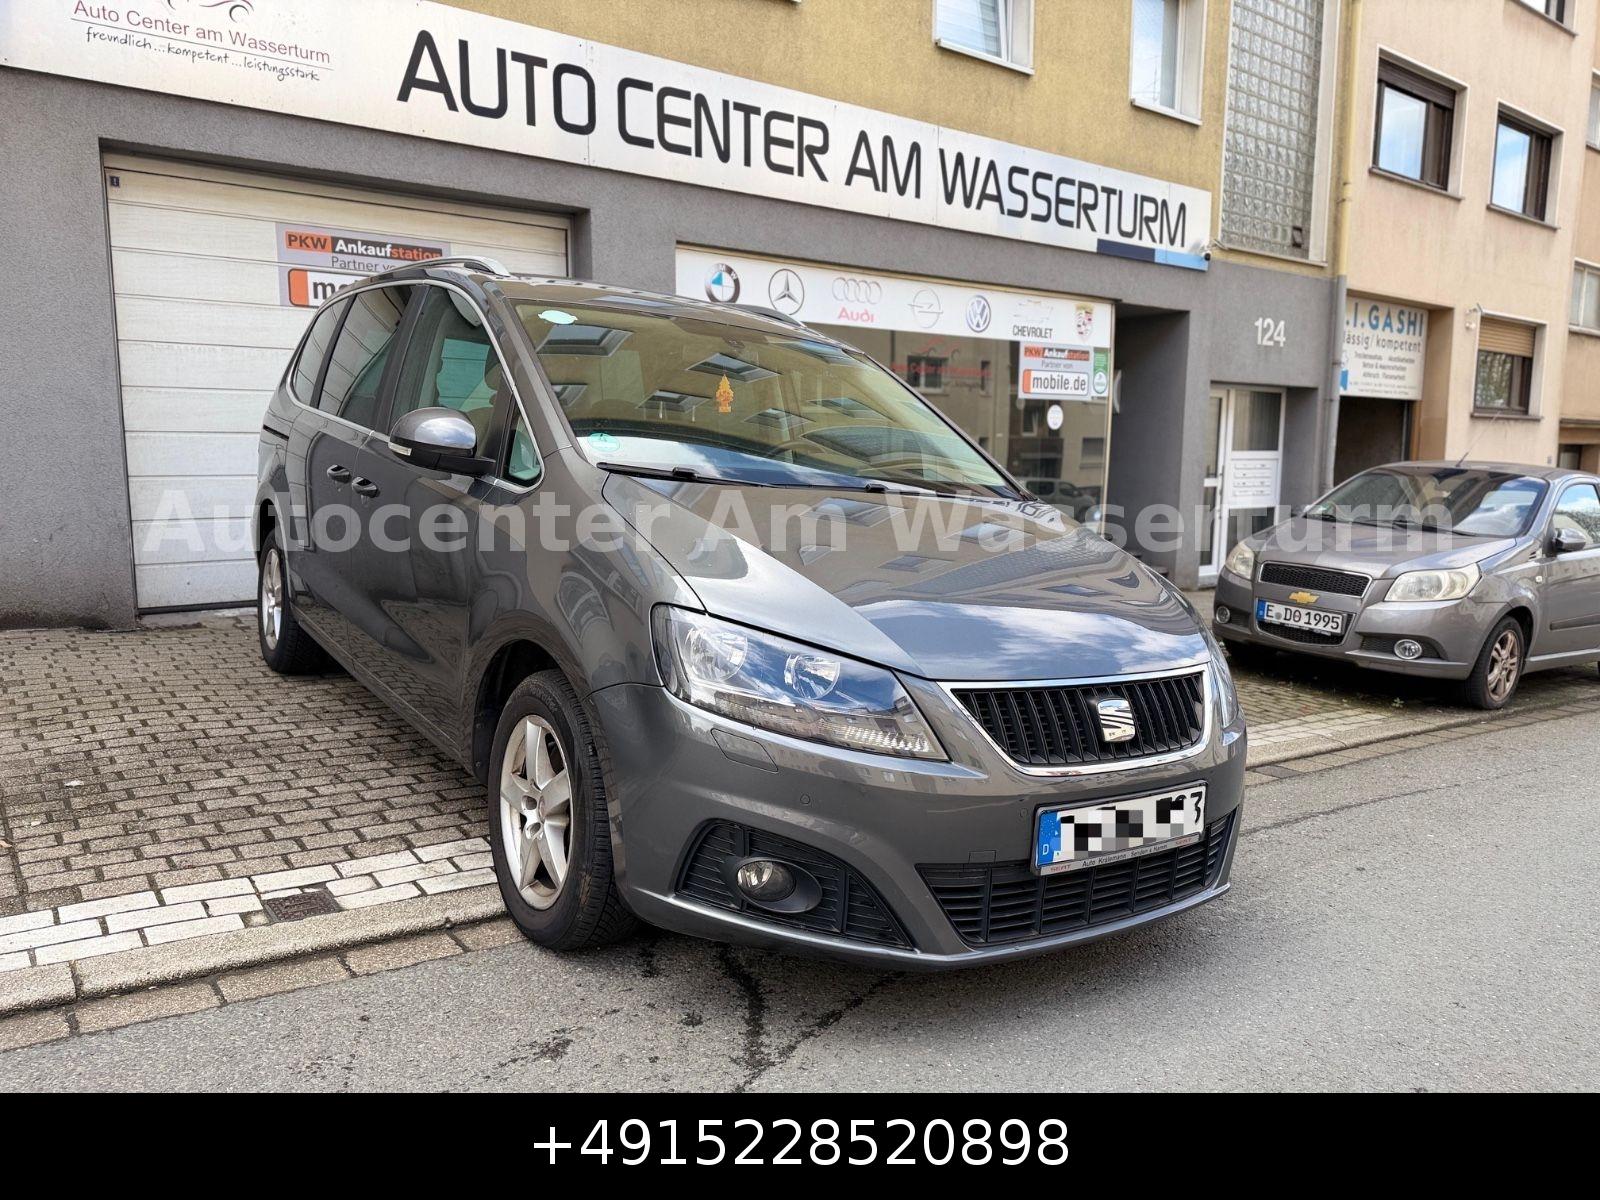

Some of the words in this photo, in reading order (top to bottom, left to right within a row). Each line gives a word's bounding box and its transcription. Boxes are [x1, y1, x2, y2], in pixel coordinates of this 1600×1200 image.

[74, 0, 120, 22] Auto
[126, 10, 190, 36] Center
[195, 27, 223, 43] am
[228, 29, 330, 64] Wasserturm
[396, 29, 597, 136] AUTO
[616, 76, 830, 183] CENTER
[844, 129, 922, 200] AM
[938, 147, 1187, 248] WASSERTURM
[286, 232, 328, 250] PKW
[331, 255, 379, 272] Partner
[837, 306, 875, 324] Audi
[1012, 324, 1054, 339] CHEVROLET
[1254, 317, 1287, 347] 124
[1032, 373, 1087, 391] mobile.de
[1265, 604, 1275, 619] E
[1303, 611, 1341, 630] 1995
[1042, 843, 1050, 856] D
